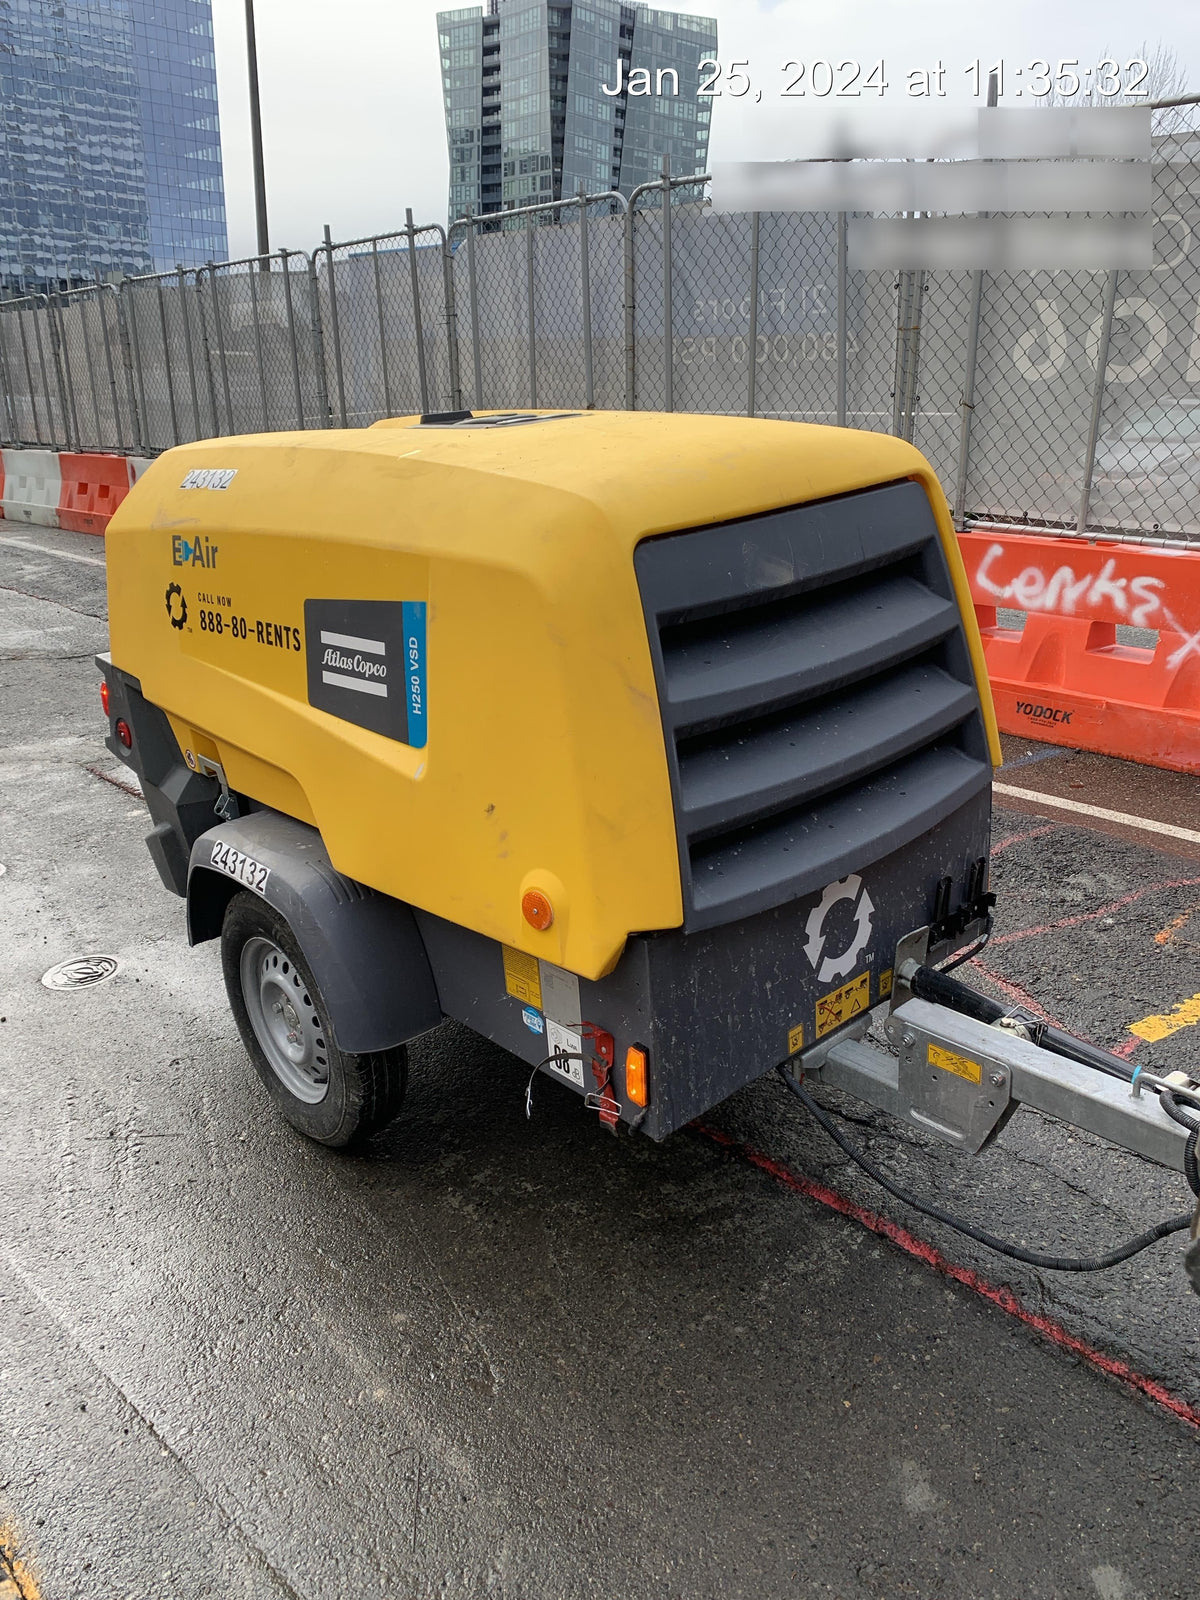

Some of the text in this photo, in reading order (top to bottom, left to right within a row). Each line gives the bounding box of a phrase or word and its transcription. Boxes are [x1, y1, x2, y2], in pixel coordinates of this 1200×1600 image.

[197, 592, 232, 608] CALL NOW
[199, 609, 302, 652] 888-80-RENTS
[408, 636, 422, 715] H250 VSD
[1016, 701, 1072, 725] YODOCK
[211, 842, 268, 892] 243132
